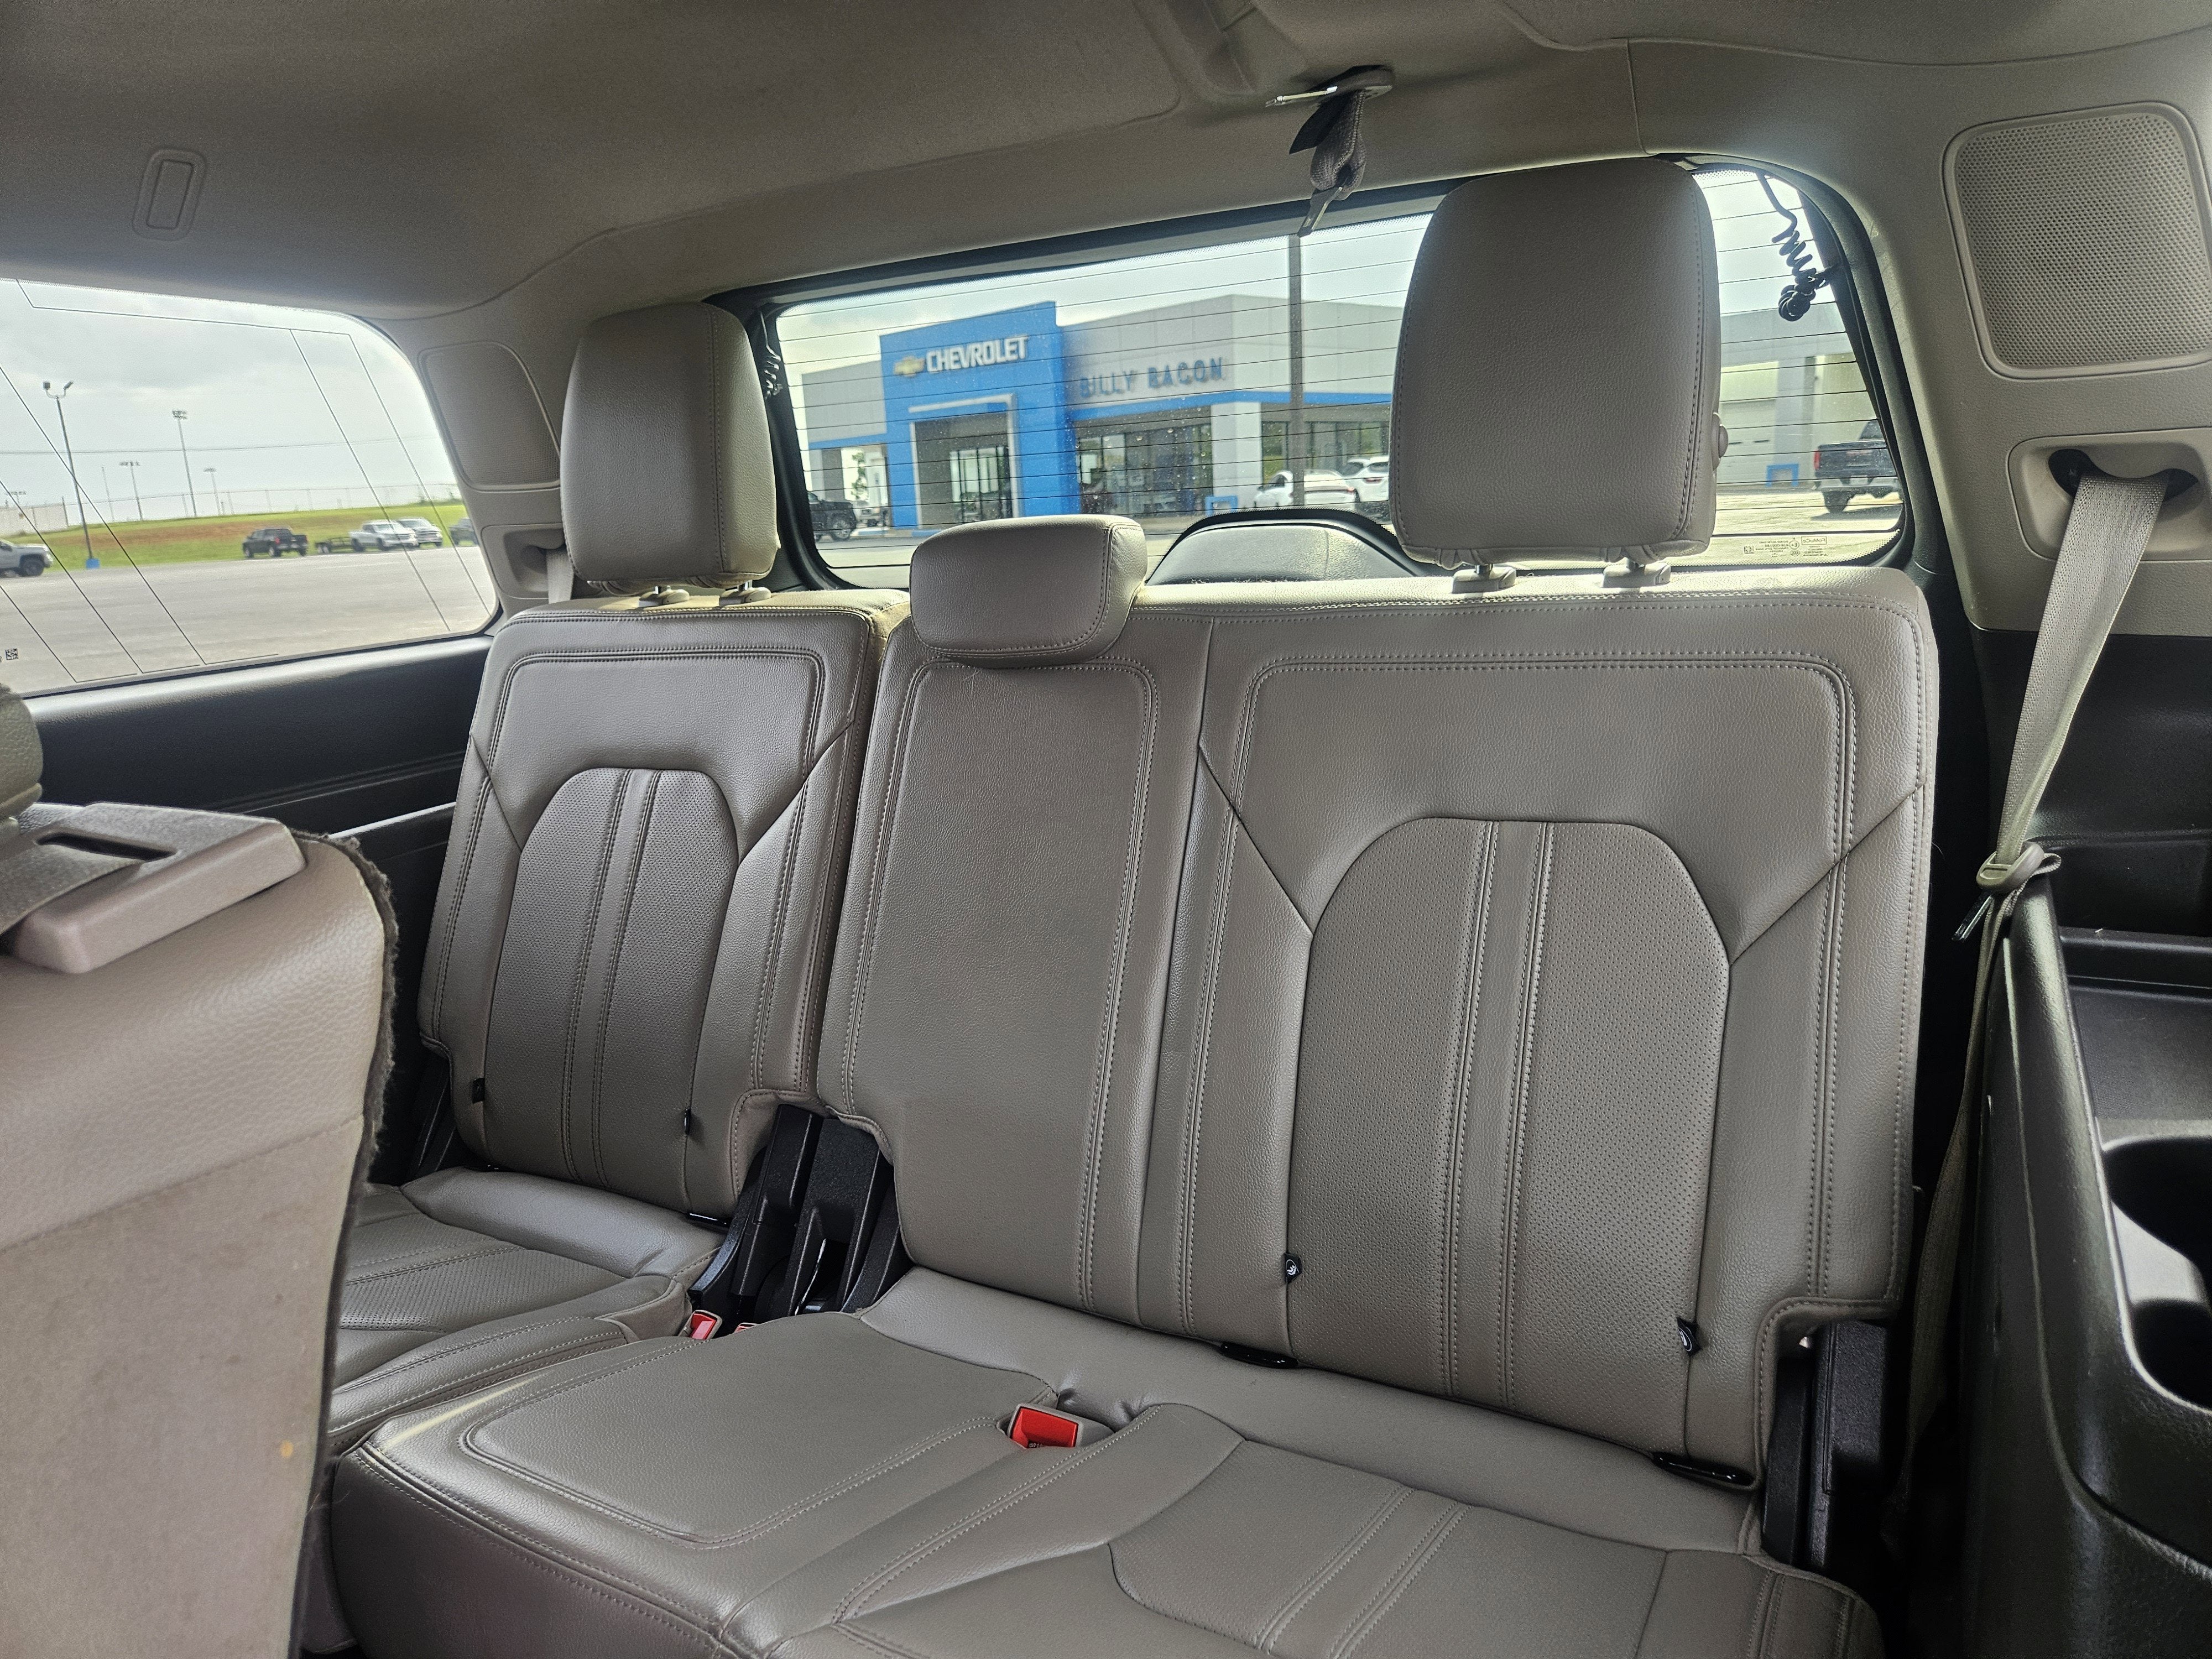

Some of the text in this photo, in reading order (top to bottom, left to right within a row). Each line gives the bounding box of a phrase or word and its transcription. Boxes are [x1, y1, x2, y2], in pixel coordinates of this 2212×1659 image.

[926, 336, 1029, 373] CHEVROLET
[1079, 357, 1223, 398] BILLY BACON
